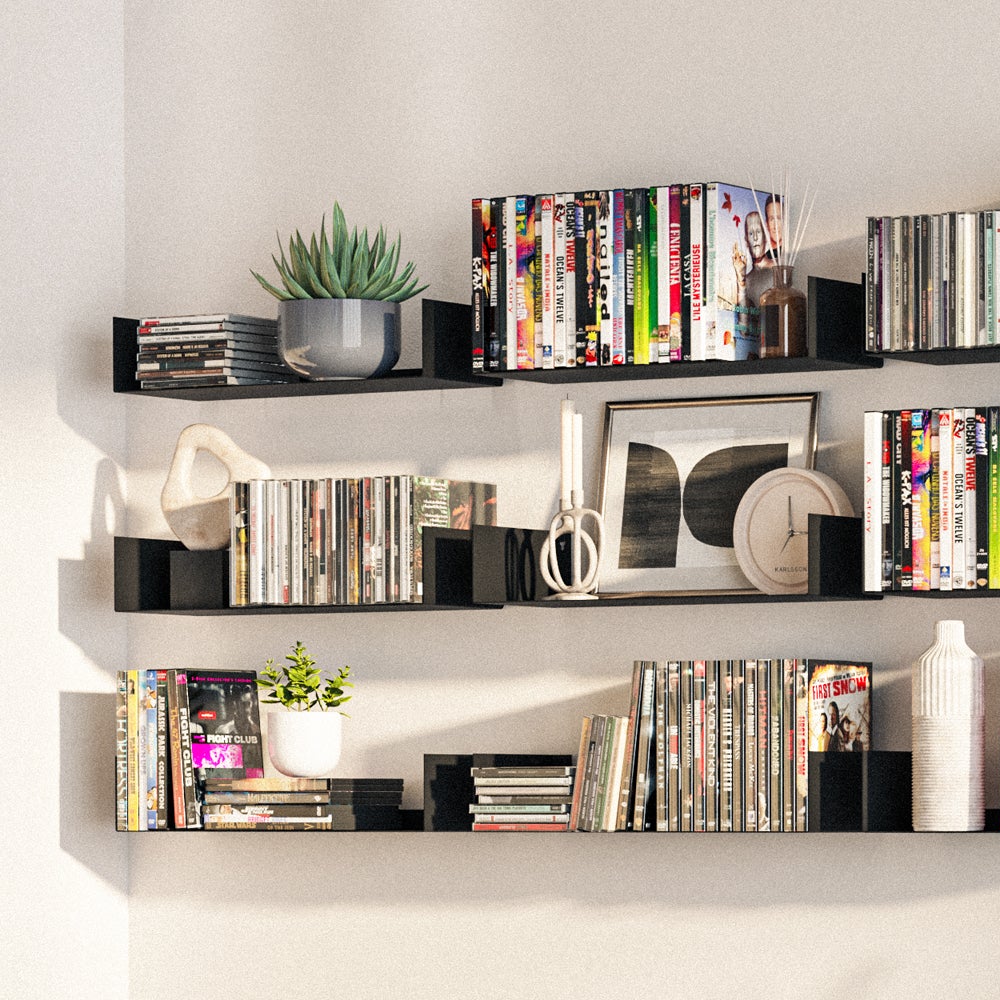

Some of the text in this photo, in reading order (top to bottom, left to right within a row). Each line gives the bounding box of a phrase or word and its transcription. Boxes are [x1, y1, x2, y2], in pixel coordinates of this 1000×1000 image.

[566, 202, 575, 273] OCEAN'S TWELVE
[600, 225, 611, 320] nailed
[473, 256, 482, 290] K-PAX
[902, 470, 911, 506] K-PAX
[966, 417, 976, 491] OCEAN'S TWELVE
[955, 474, 964, 544] OCEAN'S TWELVE
[812, 676, 867, 700] FIRST SNOW
[180, 708, 193, 787] FIGHT CLUB
[207, 734, 258, 744] FIGHT CLUB
